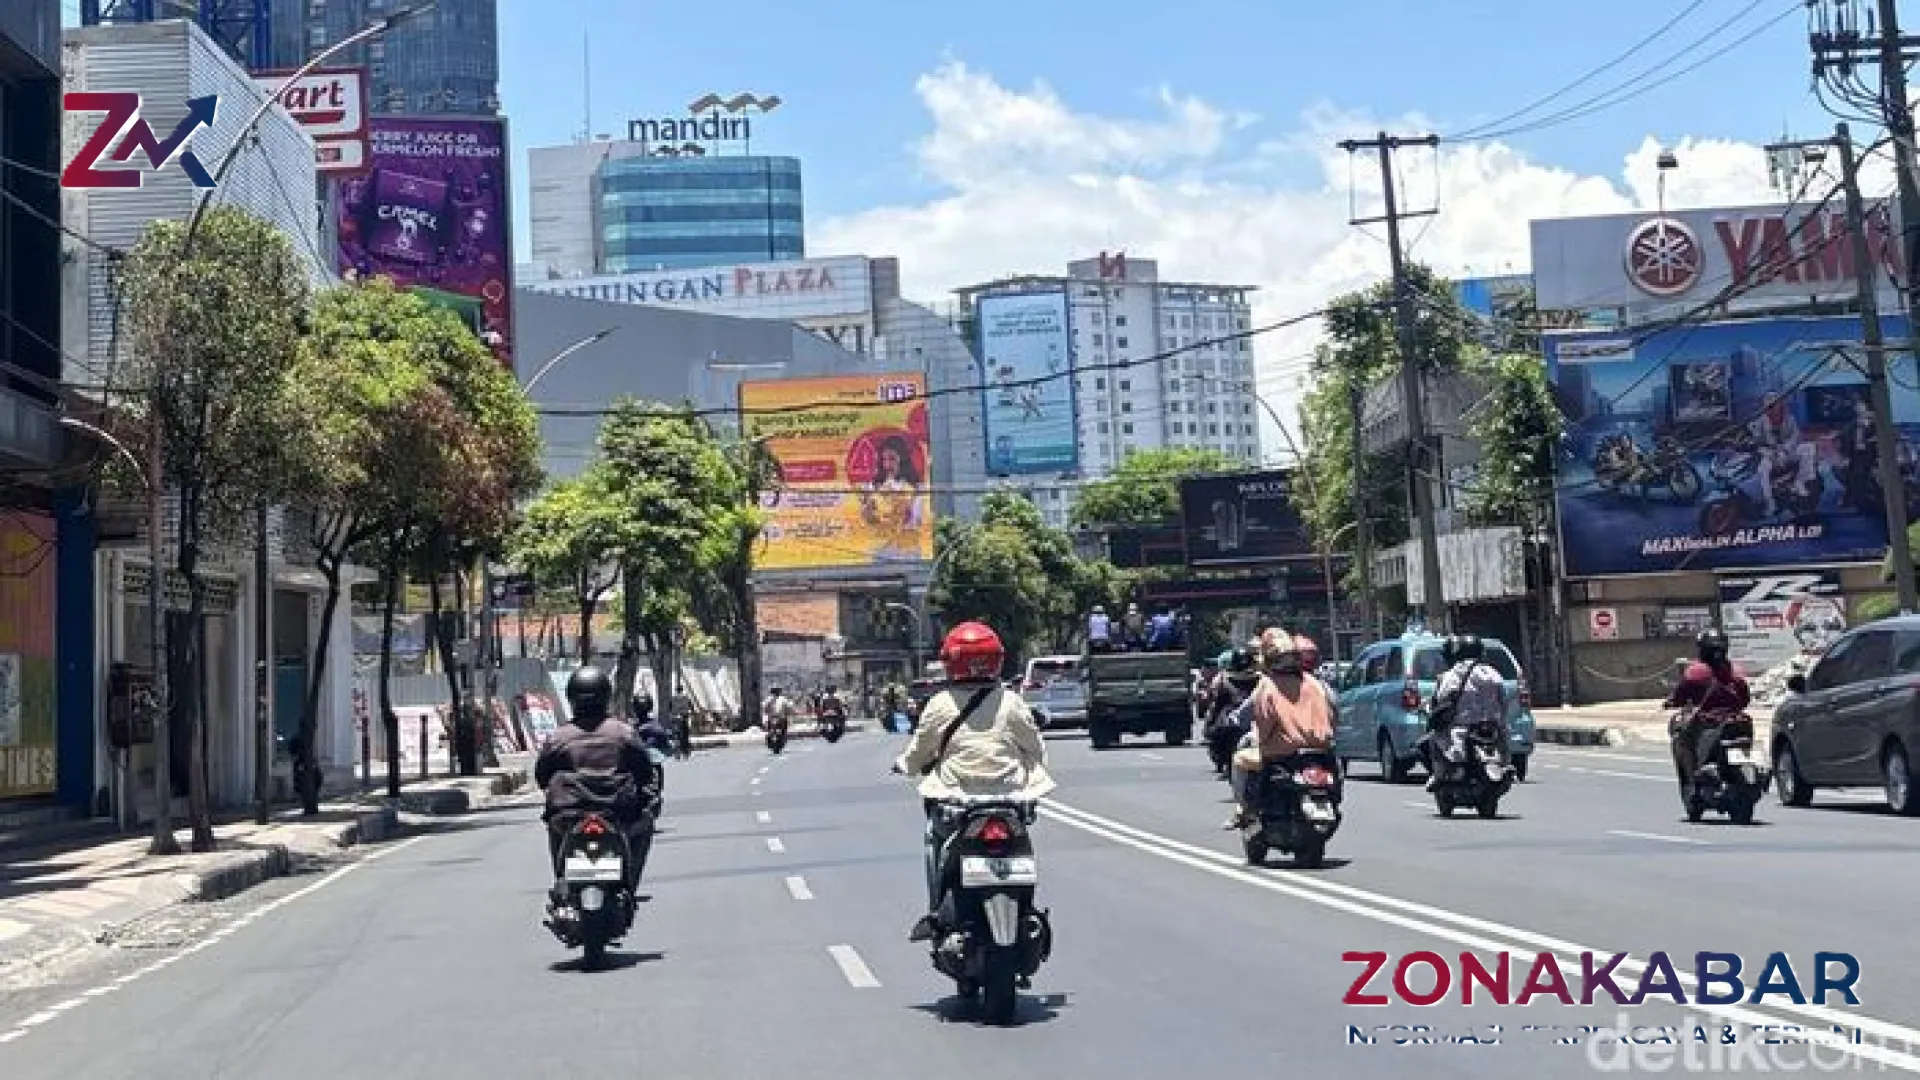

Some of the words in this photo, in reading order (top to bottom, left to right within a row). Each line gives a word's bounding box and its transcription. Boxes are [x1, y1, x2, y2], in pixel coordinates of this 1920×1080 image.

[628, 111, 750, 141] mandiri
[734, 267, 836, 296] PLAZA
[1734, 524, 1795, 545] ALPHA
